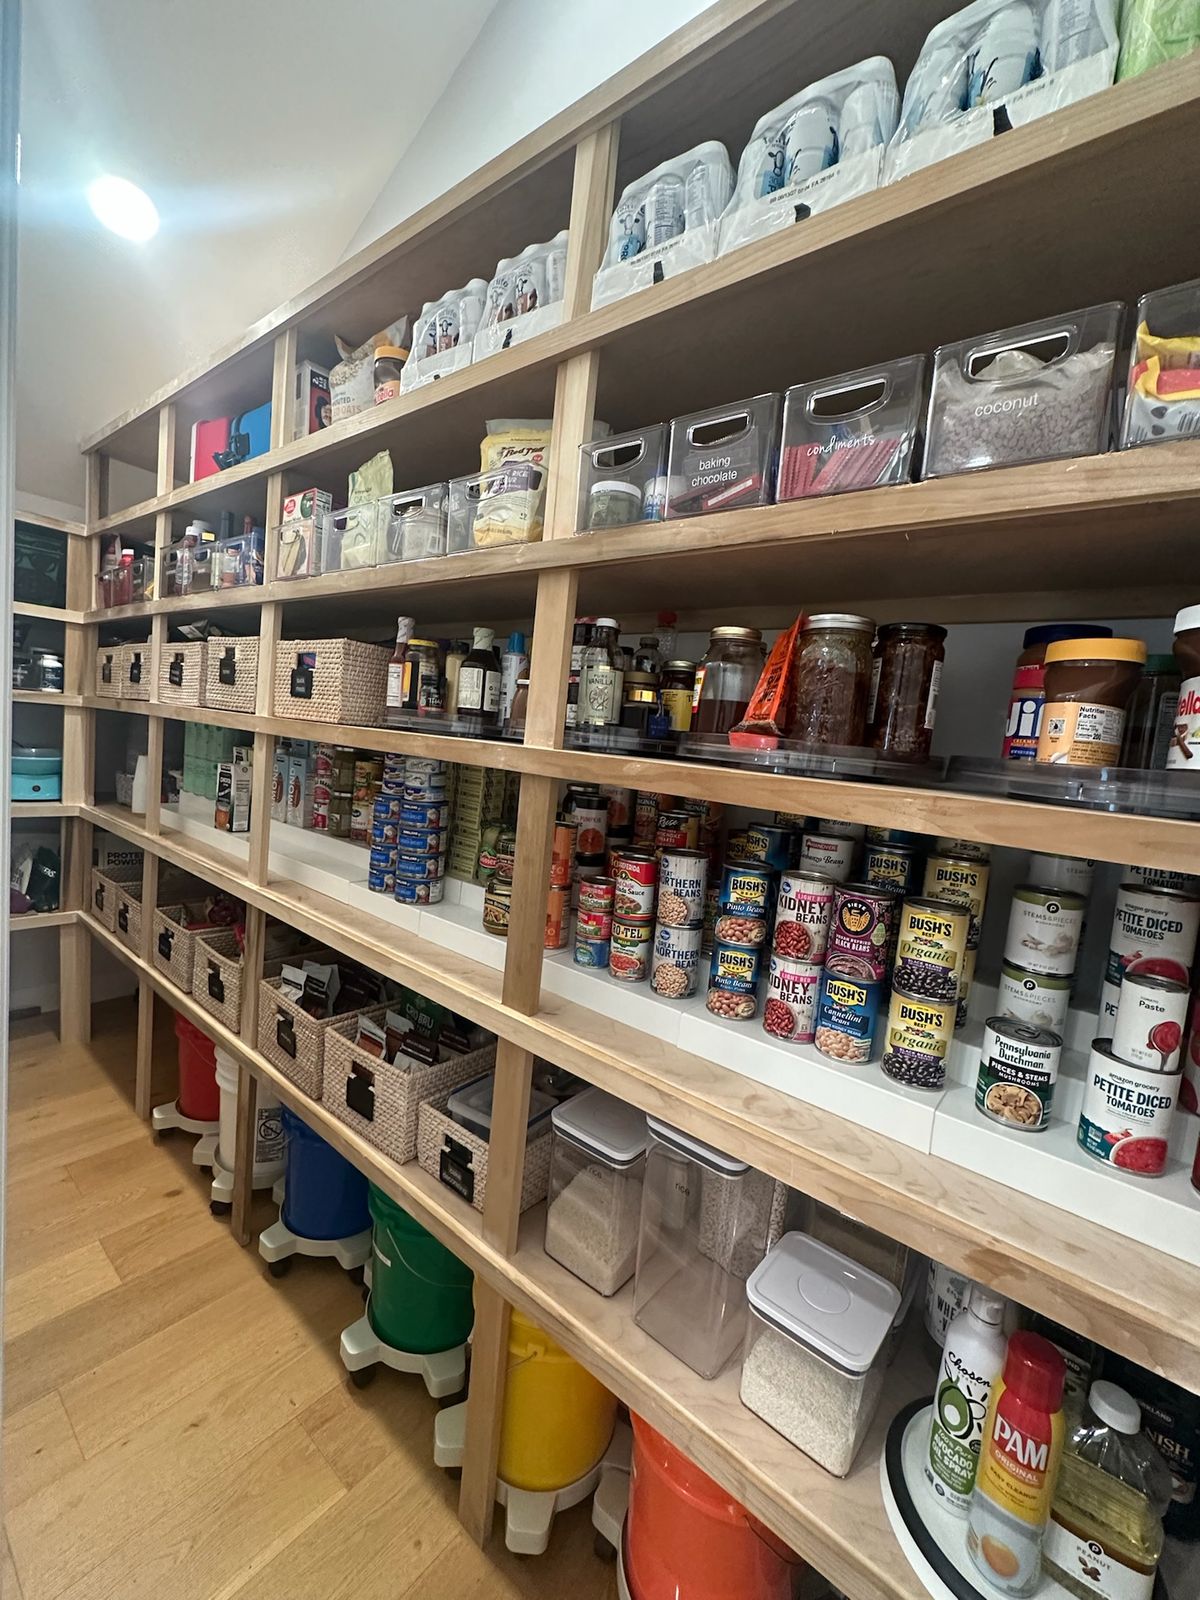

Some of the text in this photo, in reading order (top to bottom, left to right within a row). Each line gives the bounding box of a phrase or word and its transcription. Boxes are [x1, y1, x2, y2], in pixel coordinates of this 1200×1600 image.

[974, 392, 1039, 417] coconut
[806, 433, 876, 458] condiments
[699, 456, 731, 472] baking
[691, 469, 738, 487] chocolate
[1176, 690, 1200, 716] ella
[823, 855, 845, 865] Beans
[869, 855, 909, 873] BUSH'S
[732, 878, 767, 893] BUSH'S
[937, 868, 978, 886] BUSH'S
[627, 886, 646, 896] Sauce
[673, 888, 702, 898] BEANS
[797, 892, 815, 901] LIGHT
[726, 902, 765, 914] Pinto Beans
[779, 894, 825, 915] KIDNEY
[847, 902, 867, 912] SIETE
[1144, 907, 1169, 917] grocery
[795, 912, 828, 925] BEANS
[1023, 910, 1047, 921] STEMS
[1115, 908, 1183, 934] PETITE DICED
[909, 915, 952, 937] BUSH'S
[1122, 923, 1165, 941] TOMATOES
[655, 946, 700, 962] NORTHERN
[835, 938, 871, 953] BLACK BEANS
[901, 942, 954, 963] Organic
[675, 958, 699, 969] BEANS
[720, 952, 754, 969] BUSH'S
[715, 976, 752, 989] Pinto Beans
[781, 972, 801, 982] LIGHT
[780, 993, 813, 1005] BEANS
[827, 981, 865, 1003] BUSH'S
[1004, 984, 1024, 997] STEMS
[1029, 992, 1057, 1004] PIECES
[823, 1005, 862, 1024] Cannellini
[900, 1004, 943, 1027] BUSH'S
[1138, 1000, 1166, 1013] Paste
[831, 1015, 850, 1026] Beans
[893, 1030, 945, 1052] Organic
[995, 1035, 1051, 1059] Pennsylvania
[998, 1048, 1044, 1069] Dutchman
[991, 1061, 1016, 1076] PIECES
[1025, 1073, 1048, 1082] STEMS
[998, 1072, 1040, 1087] MUSHROOMS
[1109, 1072, 1161, 1092] amazon grocery
[1093, 1074, 1172, 1109] PETITE DICED
[1106, 1095, 1156, 1119] TOMATOES
[588, 1167, 602, 1179] rice
[675, 1183, 691, 1197] rice
[937, 1295, 955, 1319] WHE
[948, 1350, 992, 1388] Chosen
[993, 1413, 1048, 1471] PAM
[1145, 1427, 1190, 1460] NISH
[931, 1441, 942, 1460] OIL
[944, 1456, 974, 1479] SPRAY
[934, 1433, 973, 1470] AVOCADO
[954, 1446, 973, 1459] Pure
[995, 1449, 1038, 1482] ORIGINAL
[1076, 1546, 1111, 1571] PEANUT
